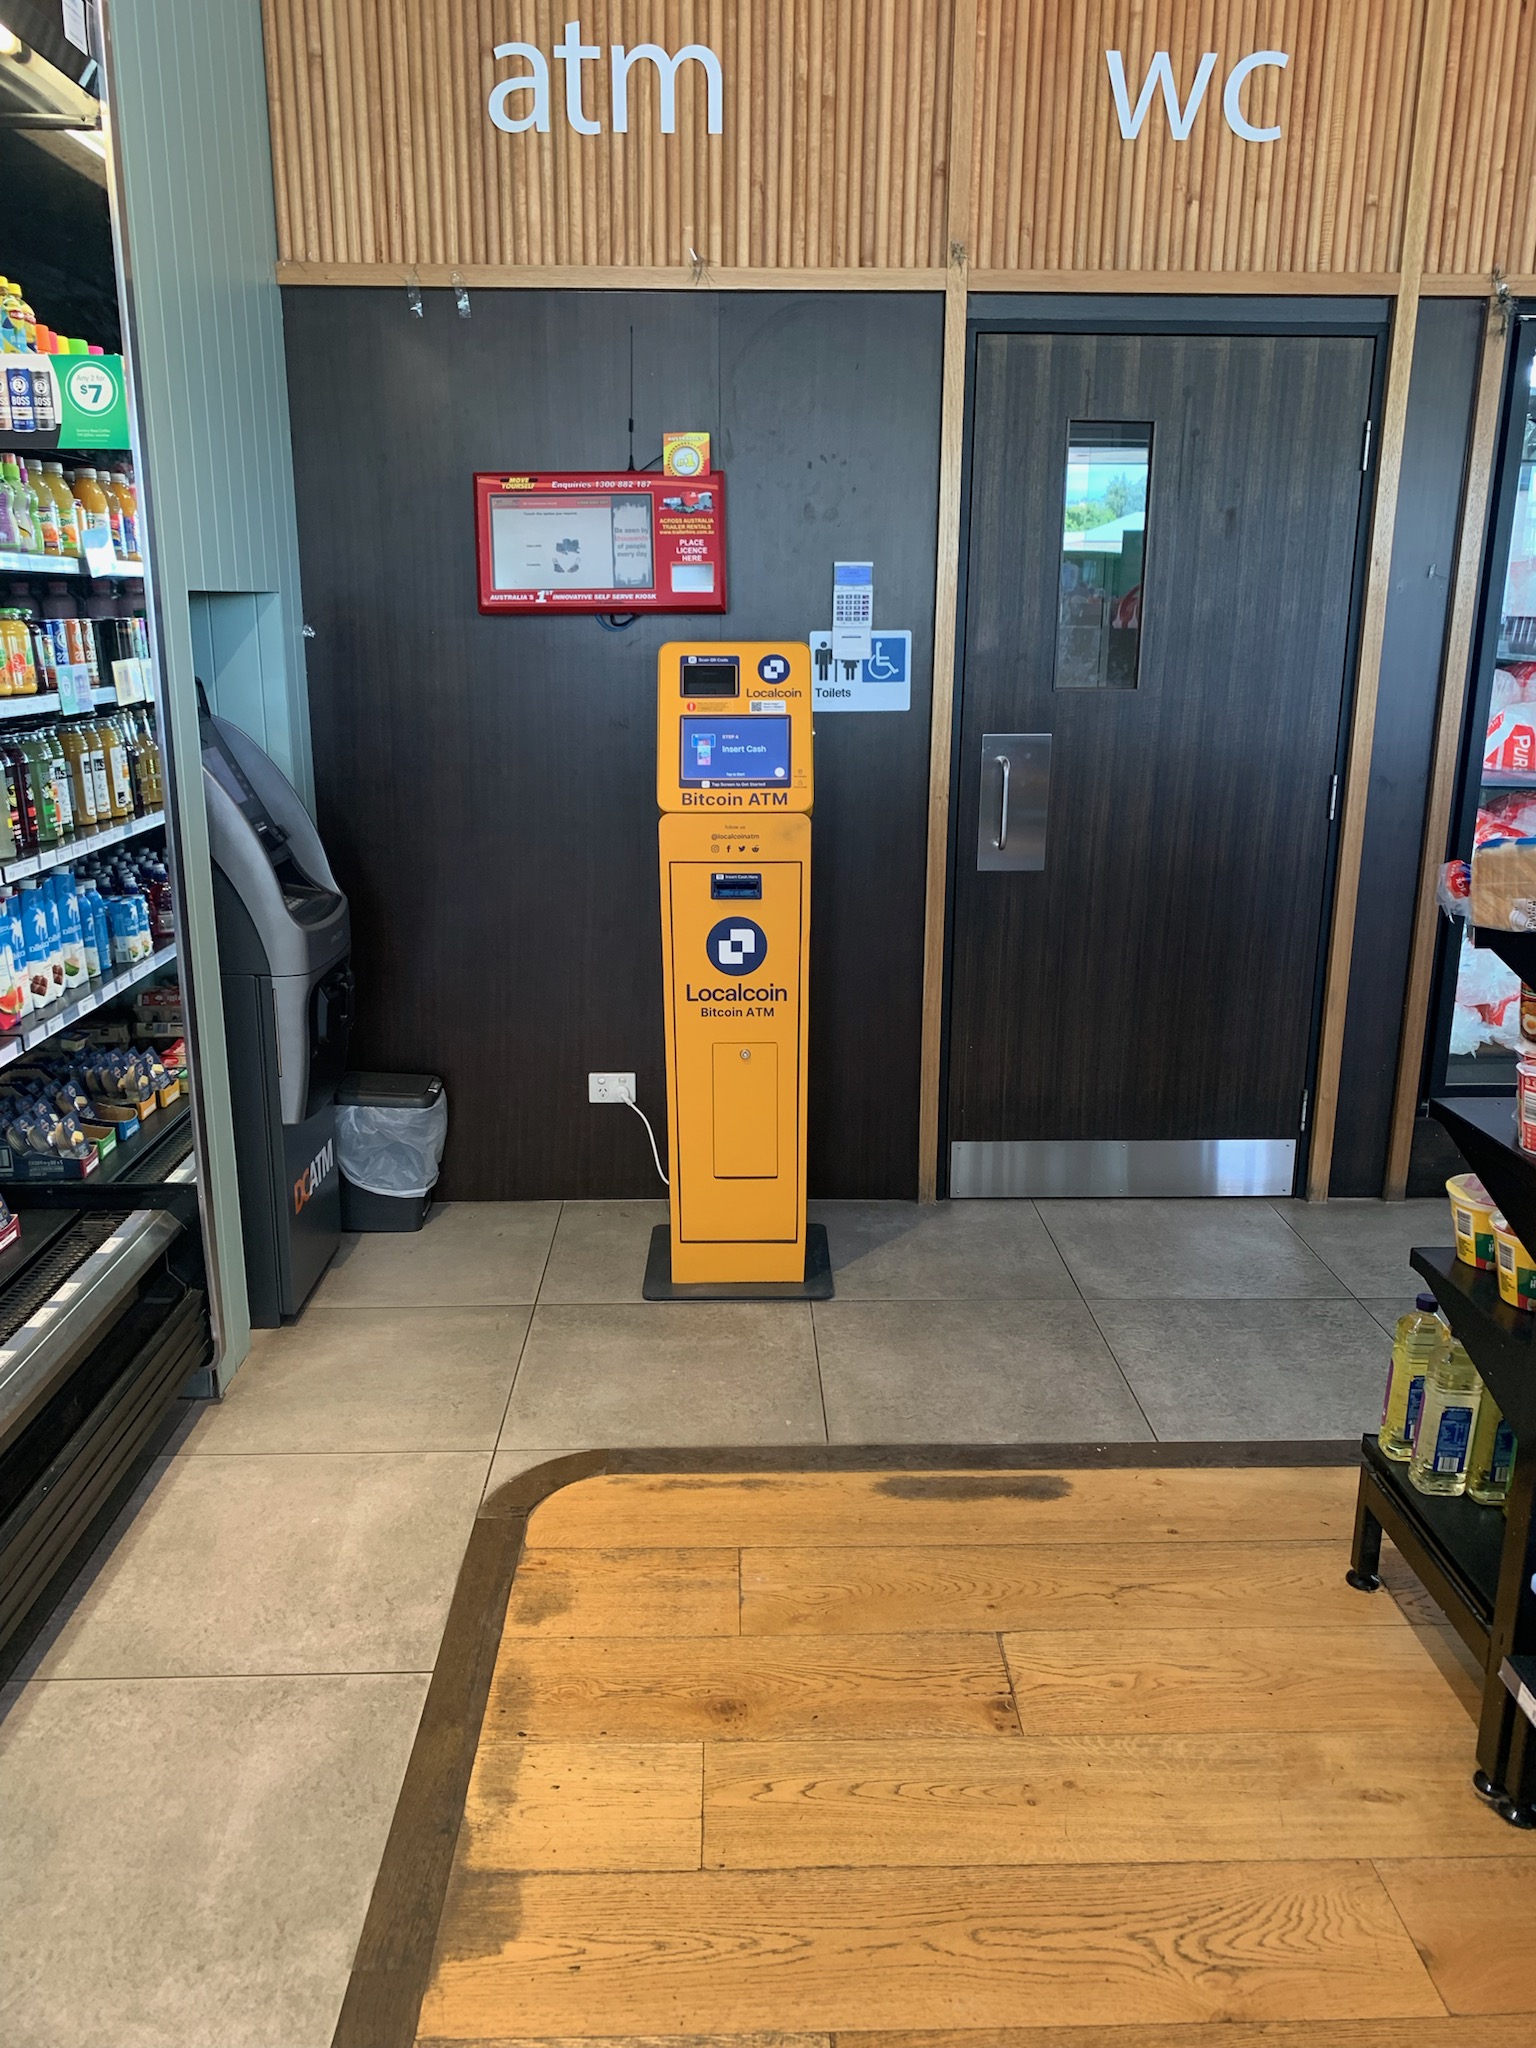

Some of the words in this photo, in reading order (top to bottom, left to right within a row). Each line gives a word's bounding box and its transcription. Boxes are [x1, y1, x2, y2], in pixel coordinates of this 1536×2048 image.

[488, 20, 723, 135] atm
[1105, 50, 1289, 142] wc
[76, 374, 88, 382] Any
[80, 384, 103, 404] $7
[11, 396, 30, 406] BOSS
[501, 482, 535, 490] YOURSELF
[551, 481, 592, 490] Enquiries
[636, 480, 652, 488] 187
[746, 688, 802, 698] Localcoin
[815, 688, 852, 698] Toilets
[746, 745, 767, 753] Cash
[1512, 734, 1531, 771] PUR
[682, 792, 743, 806] Bitcoin
[748, 793, 788, 806] ATM
[711, 833, 760, 841] @localcoinatm
[686, 983, 788, 1002] Localcoin
[700, 1007, 743, 1017] Bitcoin
[746, 1007, 775, 1017] ATM
